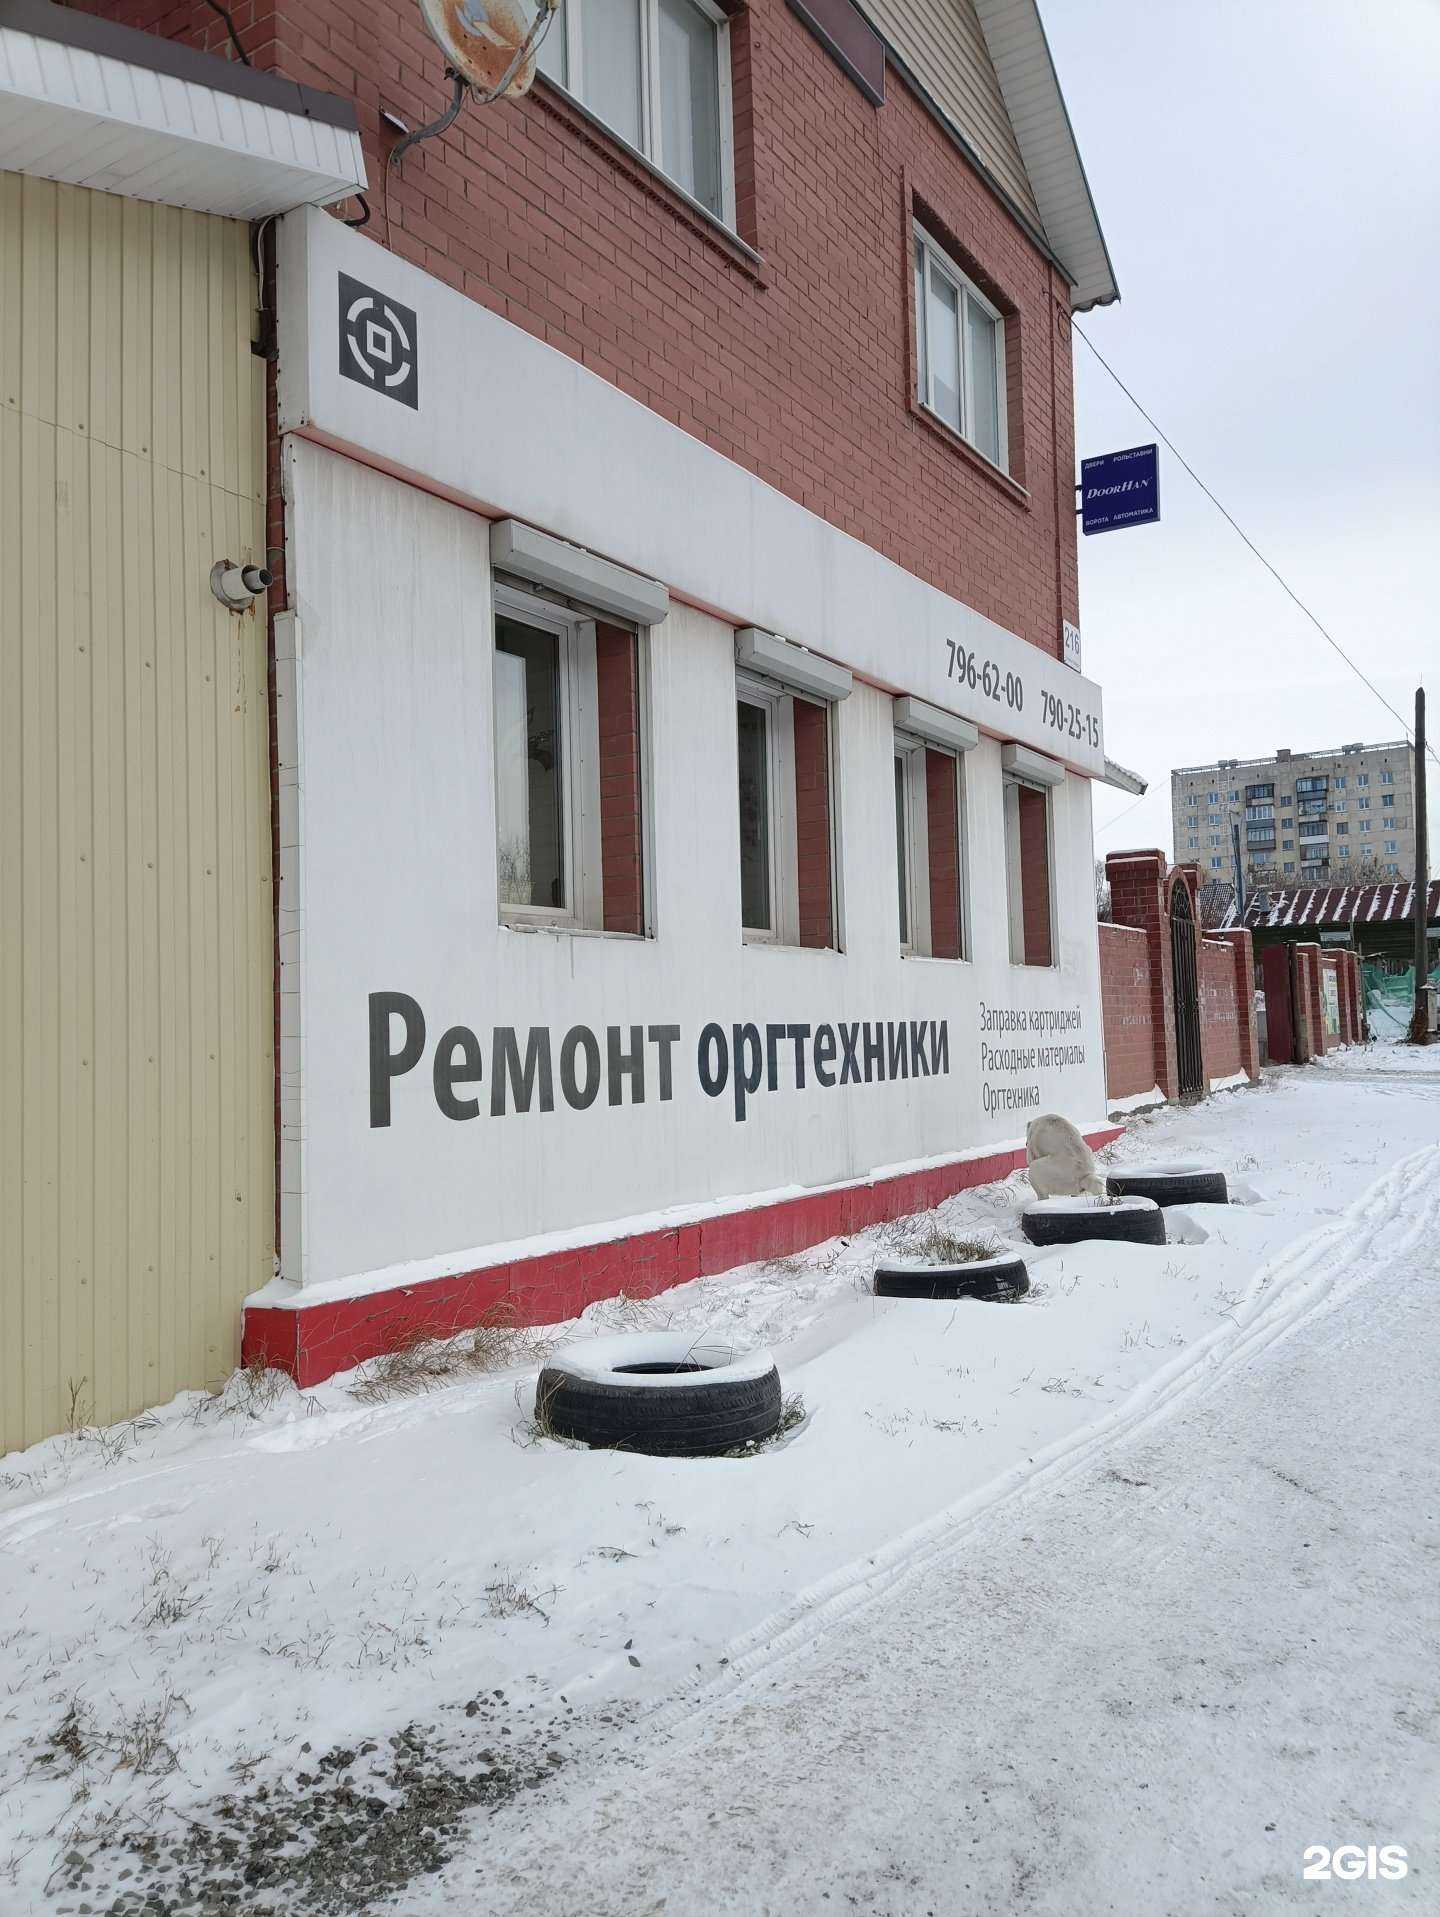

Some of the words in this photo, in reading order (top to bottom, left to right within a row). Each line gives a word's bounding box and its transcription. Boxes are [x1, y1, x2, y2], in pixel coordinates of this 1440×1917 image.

[1113, 449, 1153, 462] РОЛЬСТАВНИ
[1086, 516, 1109, 526] ВОРОТА
[1113, 507, 1154, 520] АВТОМАТИКА
[1065, 626, 1080, 655] 216
[946, 638, 1023, 712] 796-62-00
[1041, 690, 1099, 748] 790-25-15
[980, 1002, 1027, 1038] Заправка
[1029, 1005, 1081, 1037] картриджей
[368, 991, 680, 1128] Ремонт
[697, 1020, 950, 1122] оргтехники
[981, 1042, 1036, 1075] Расходные
[1038, 1044, 1085, 1072] материалы
[983, 1082, 1040, 1119] Оргтехника
